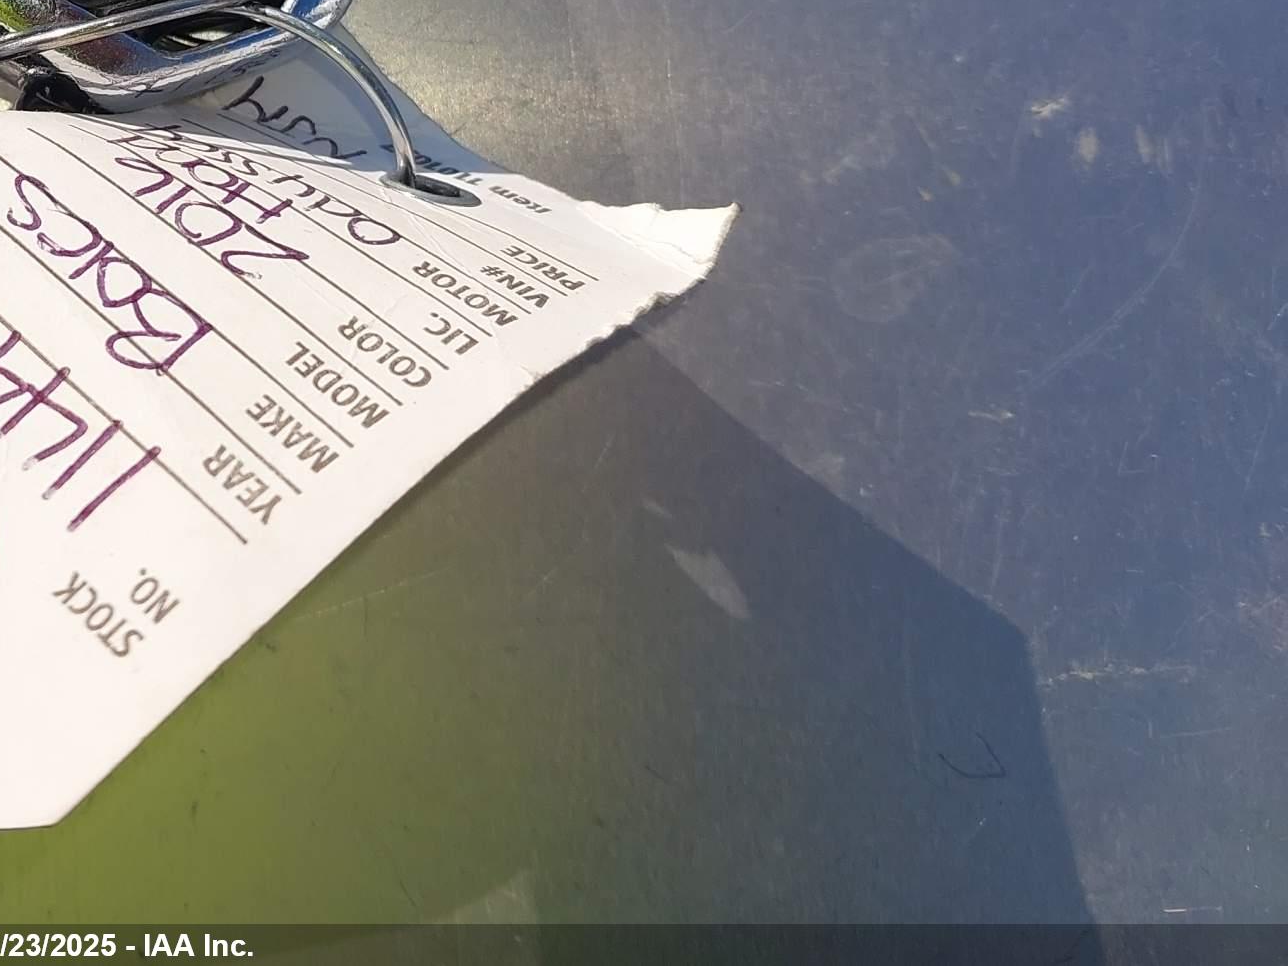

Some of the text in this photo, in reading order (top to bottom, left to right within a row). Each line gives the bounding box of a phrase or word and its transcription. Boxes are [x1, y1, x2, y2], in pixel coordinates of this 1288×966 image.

[115, 157, 310, 278] 2016
[489, 185, 553, 214] Item
[412, 261, 519, 326] MOTOR
[480, 265, 550, 309] VIN#
[500, 245, 586, 291] PRICE
[337, 316, 432, 387] COLOR
[423, 312, 479, 355] LIC.
[285, 341, 391, 429] MODEL
[245, 394, 340, 473] MAKE
[203, 444, 282, 525] YEAR
[53, 571, 144, 658] STOCK
[130, 567, 181, 624] NO.
